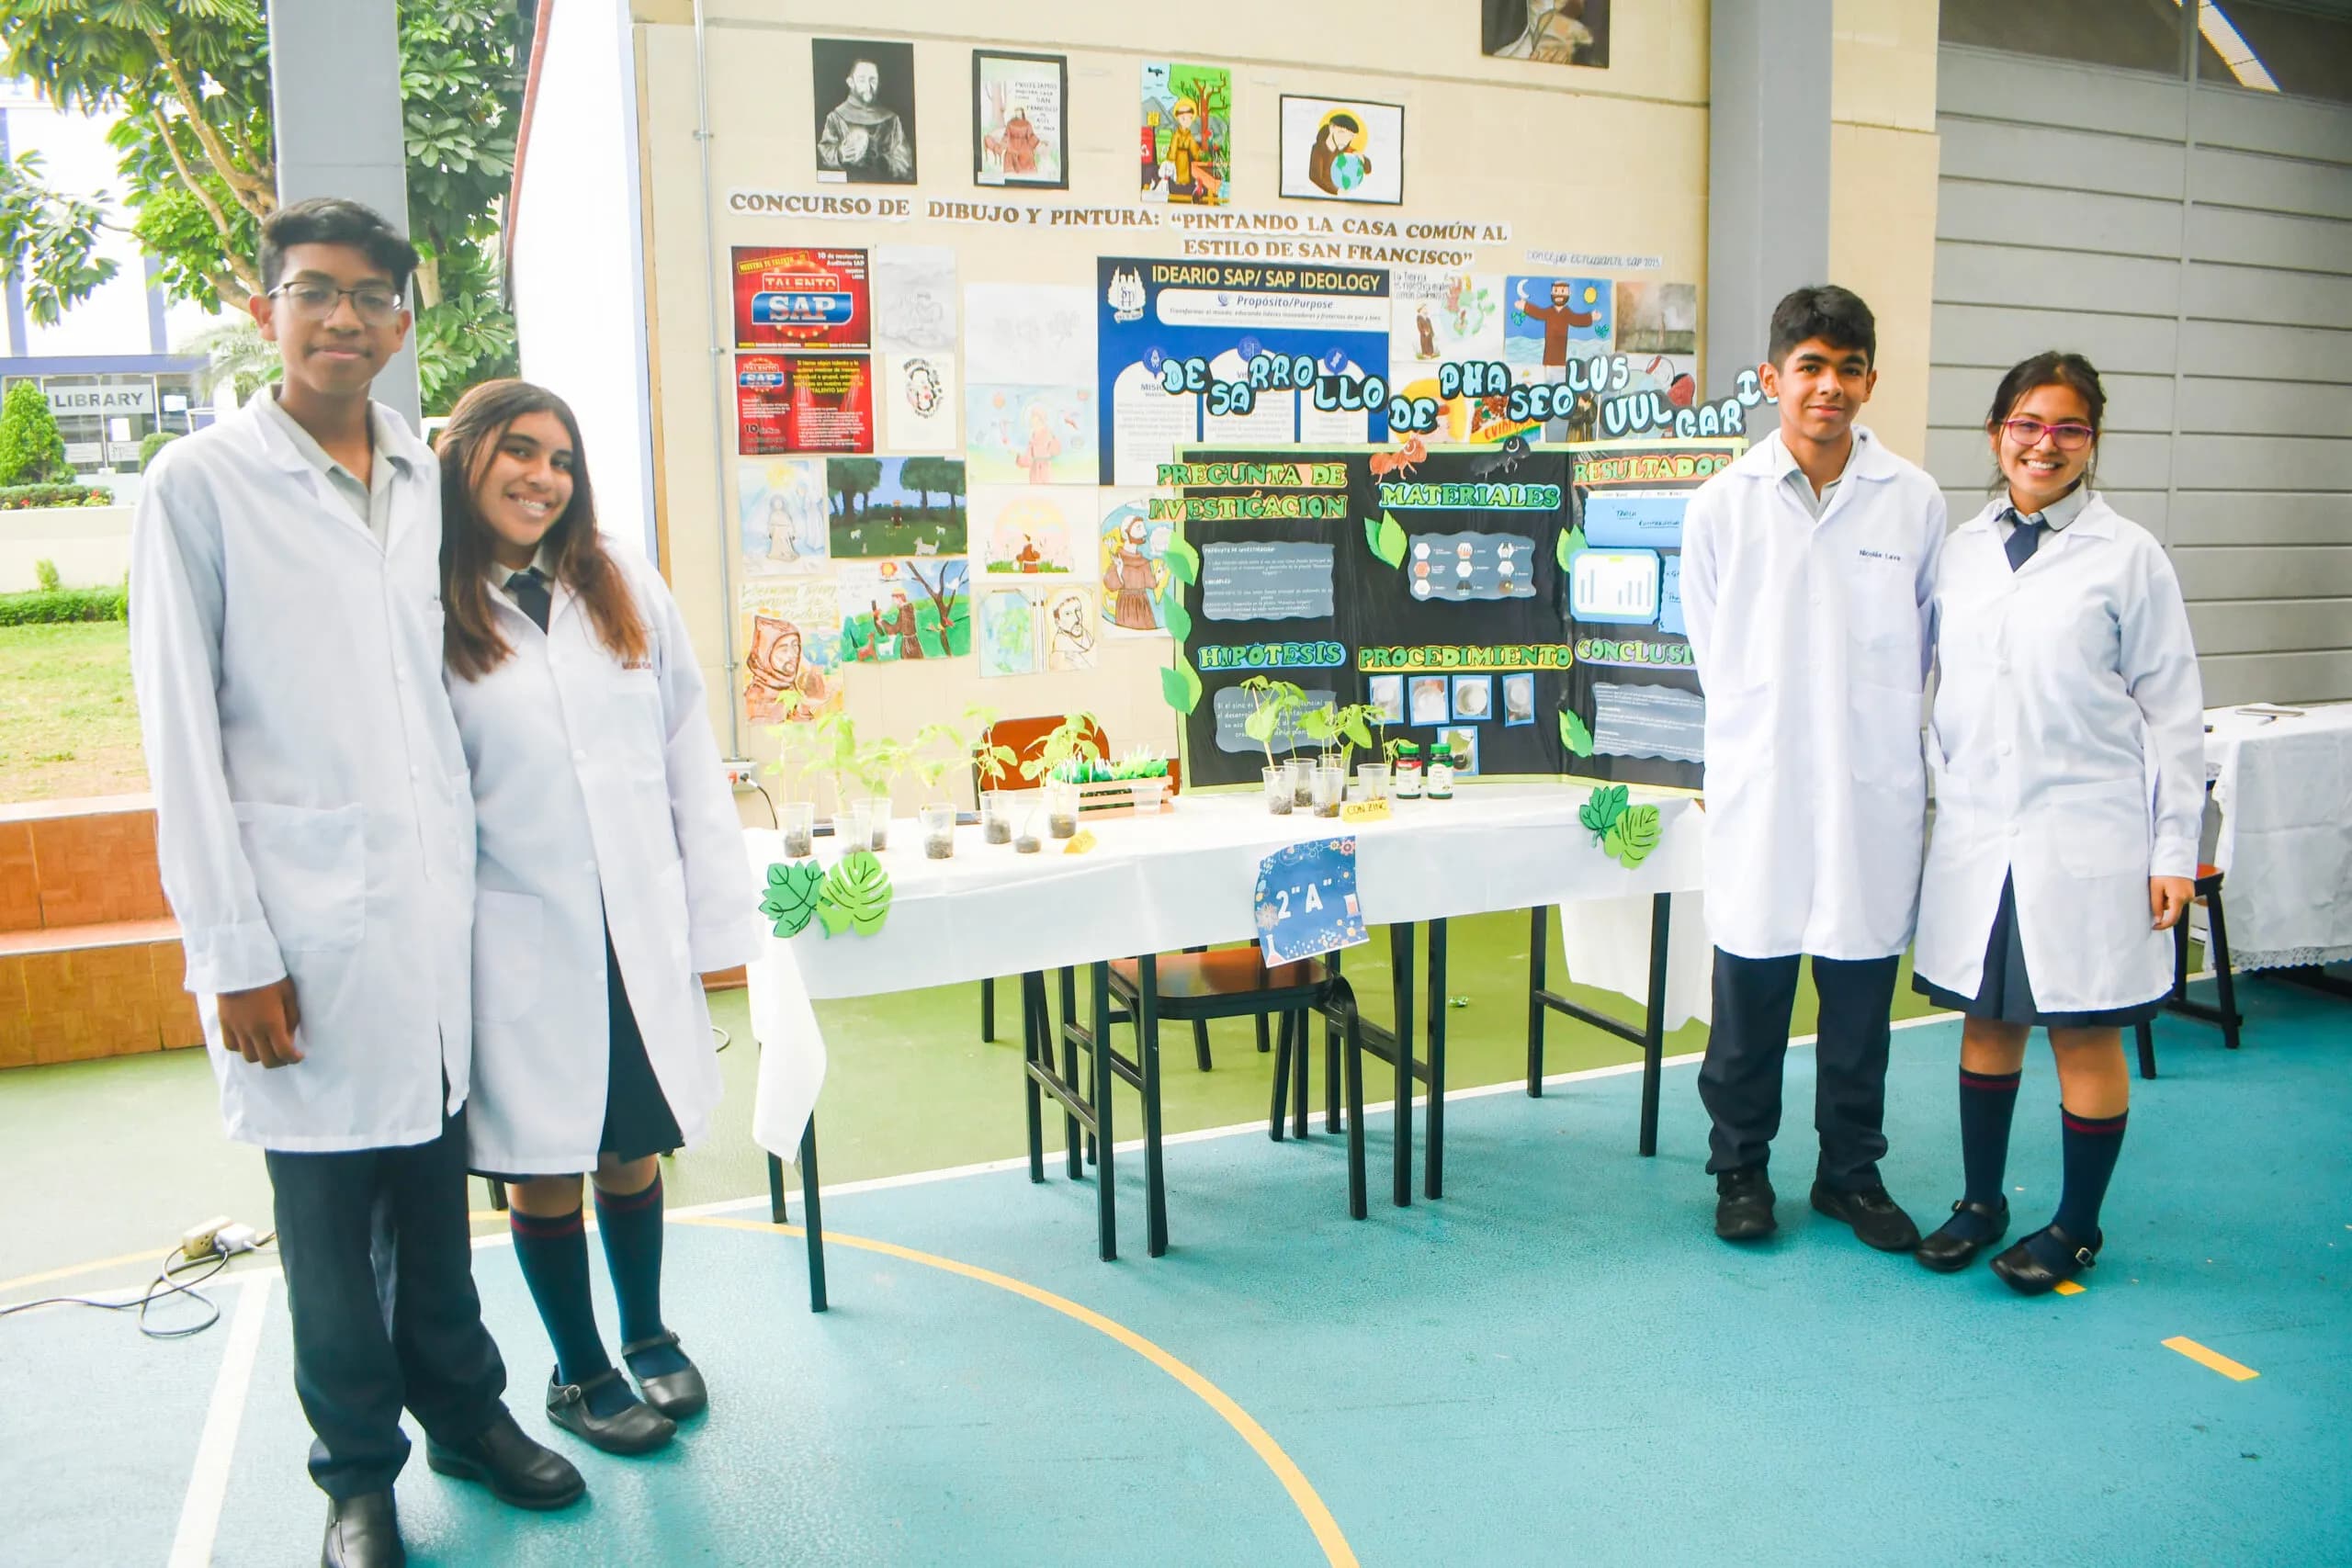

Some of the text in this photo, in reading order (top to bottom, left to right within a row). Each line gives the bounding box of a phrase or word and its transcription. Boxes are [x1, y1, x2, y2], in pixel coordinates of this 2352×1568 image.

[730, 193, 872, 215] CONCURSO
[878, 198, 910, 216] DE
[928, 200, 1020, 223] DIBUJO
[1026, 208, 1042, 224] Y
[1050, 209, 1160, 226] PINTURA:
[1307, 216, 1335, 233] LA
[1342, 218, 1397, 237] CASA
[1406, 220, 1477, 241] COMÚN
[1481, 225, 1509, 241] AL
[1183, 239, 1261, 257] ESTILO
[1266, 242, 1295, 258] DE
[1298, 243, 1341, 258] SAN
[764, 277, 836, 290] TALENTO
[1152, 265, 1380, 292] IDEARIO SAP/ SAP IDEOLOGY
[769, 295, 836, 321] SAP
[55, 392, 144, 407] LIBRARY
[1604, 369, 1779, 439] VULGARI
[1389, 396, 1437, 432] DE
[1157, 463, 1348, 486] PREGUNTA DE
[1573, 455, 1729, 483] RESULTADOS
[1380, 484, 1559, 507] MATERIALES
[1359, 646, 1572, 668] PROCEDIMIENTO
[1576, 637, 1695, 666] CONCLUSI
[1347, 804, 1365, 816] CON
